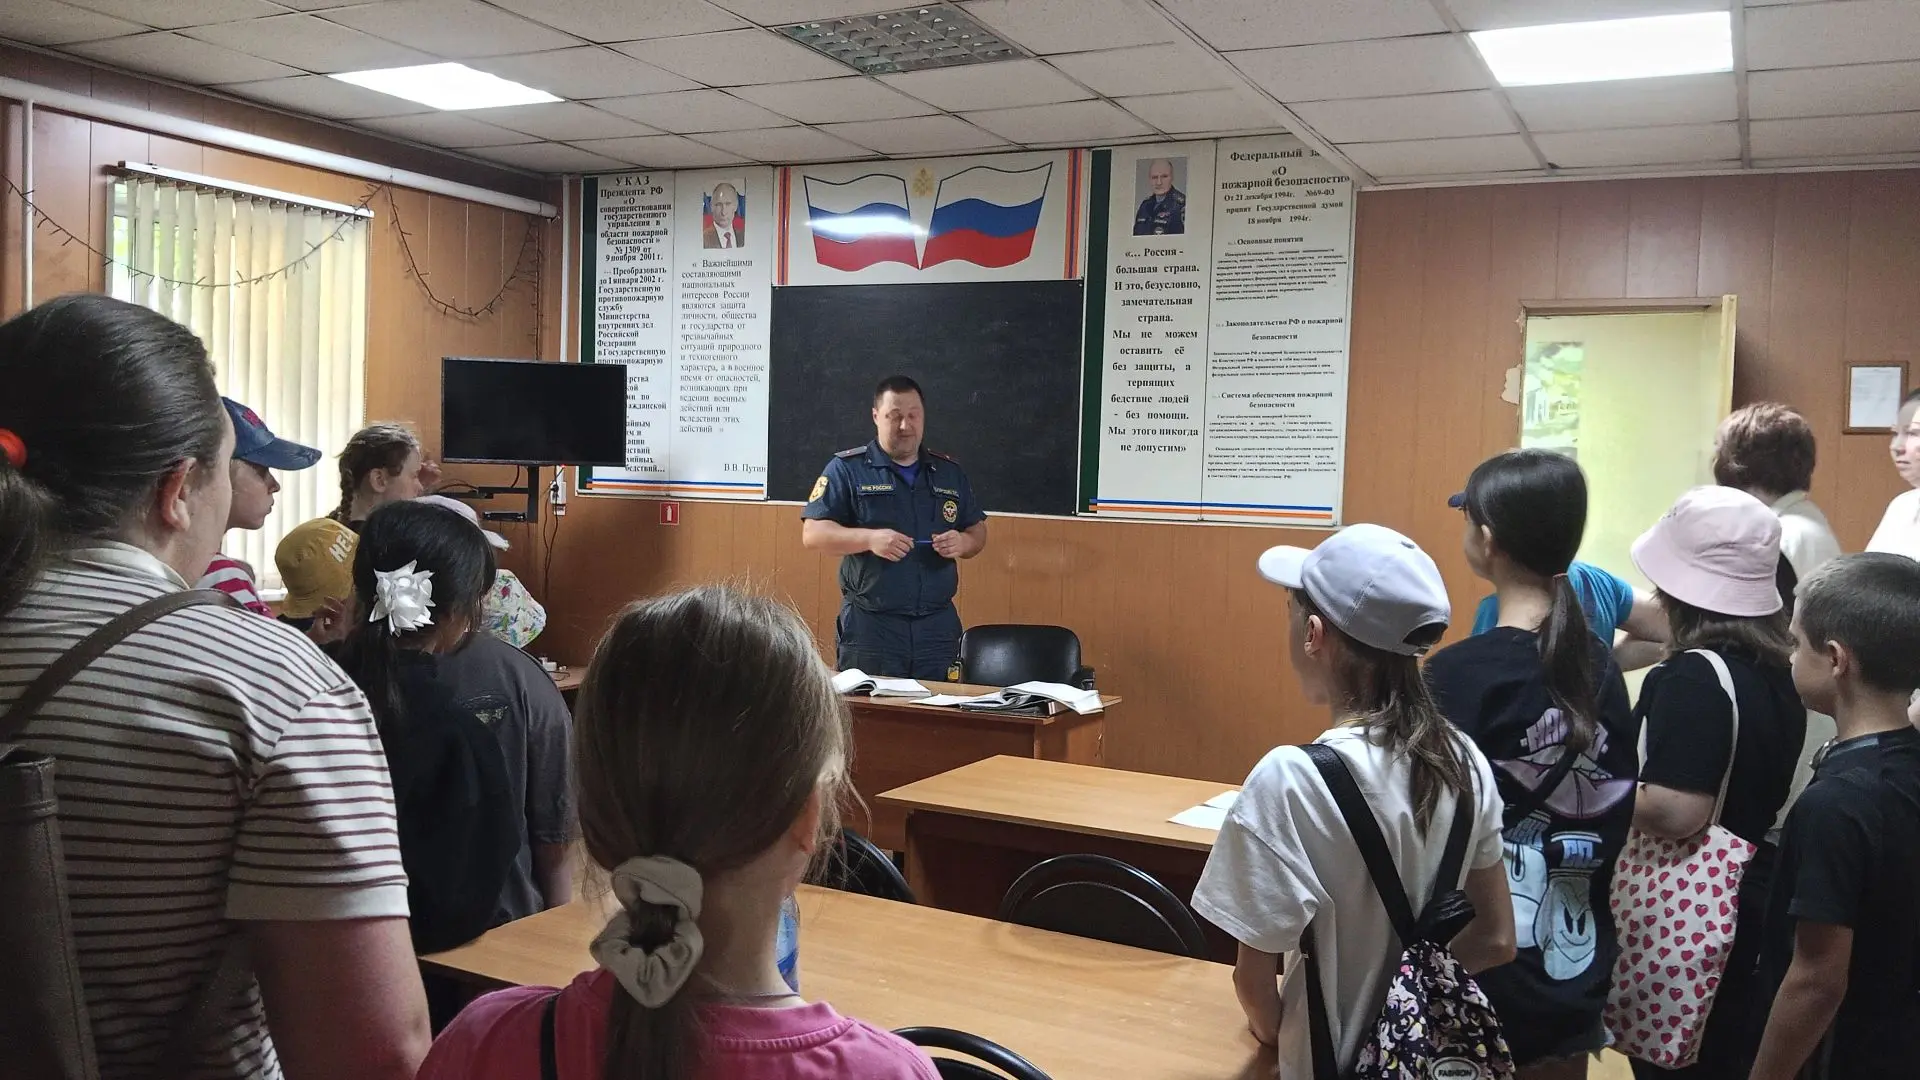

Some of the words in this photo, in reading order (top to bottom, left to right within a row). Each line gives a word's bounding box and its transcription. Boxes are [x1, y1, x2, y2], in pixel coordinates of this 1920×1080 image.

[1230, 149, 1302, 162] Федеральный
[1272, 166, 1286, 176] «О
[1222, 178, 1272, 190] пожарной
[1275, 176, 1350, 187] безопасности»
[601, 189, 645, 199] Президента
[650, 186, 663, 195] РФ
[1257, 203, 1316, 212] Государственной
[608, 220, 650, 229] управления
[632, 228, 668, 237] пожарной
[1144, 248, 1177, 257] Россия
[611, 254, 636, 262] ноября
[702, 259, 752, 268] Важнейшими
[1116, 265, 1158, 274] большая
[1164, 265, 1200, 274] страна.
[1114, 282, 1123, 290] И
[1126, 283, 1143, 292] это,
[1145, 280, 1200, 291] безусловно,
[1121, 297, 1193, 306] замечательная
[599, 313, 650, 321] Министерства
[722, 311, 756, 320] общества
[1138, 314, 1173, 323] страна.
[1307, 318, 1343, 326] пожарной
[1112, 330, 1130, 339] Мы
[1174, 346, 1185, 355] её
[1112, 362, 1127, 371] без
[1134, 363, 1175, 372] защиты,
[1128, 379, 1175, 388] терпящих
[1111, 394, 1152, 404] бедствие
[1158, 394, 1189, 404] людей
[1126, 410, 1140, 419] без
[1148, 411, 1189, 421] помощи.
[1108, 427, 1126, 435] Мы
[1132, 428, 1157, 436] этого
[1159, 427, 1198, 437] никогда
[1135, 444, 1186, 453] допустим»
